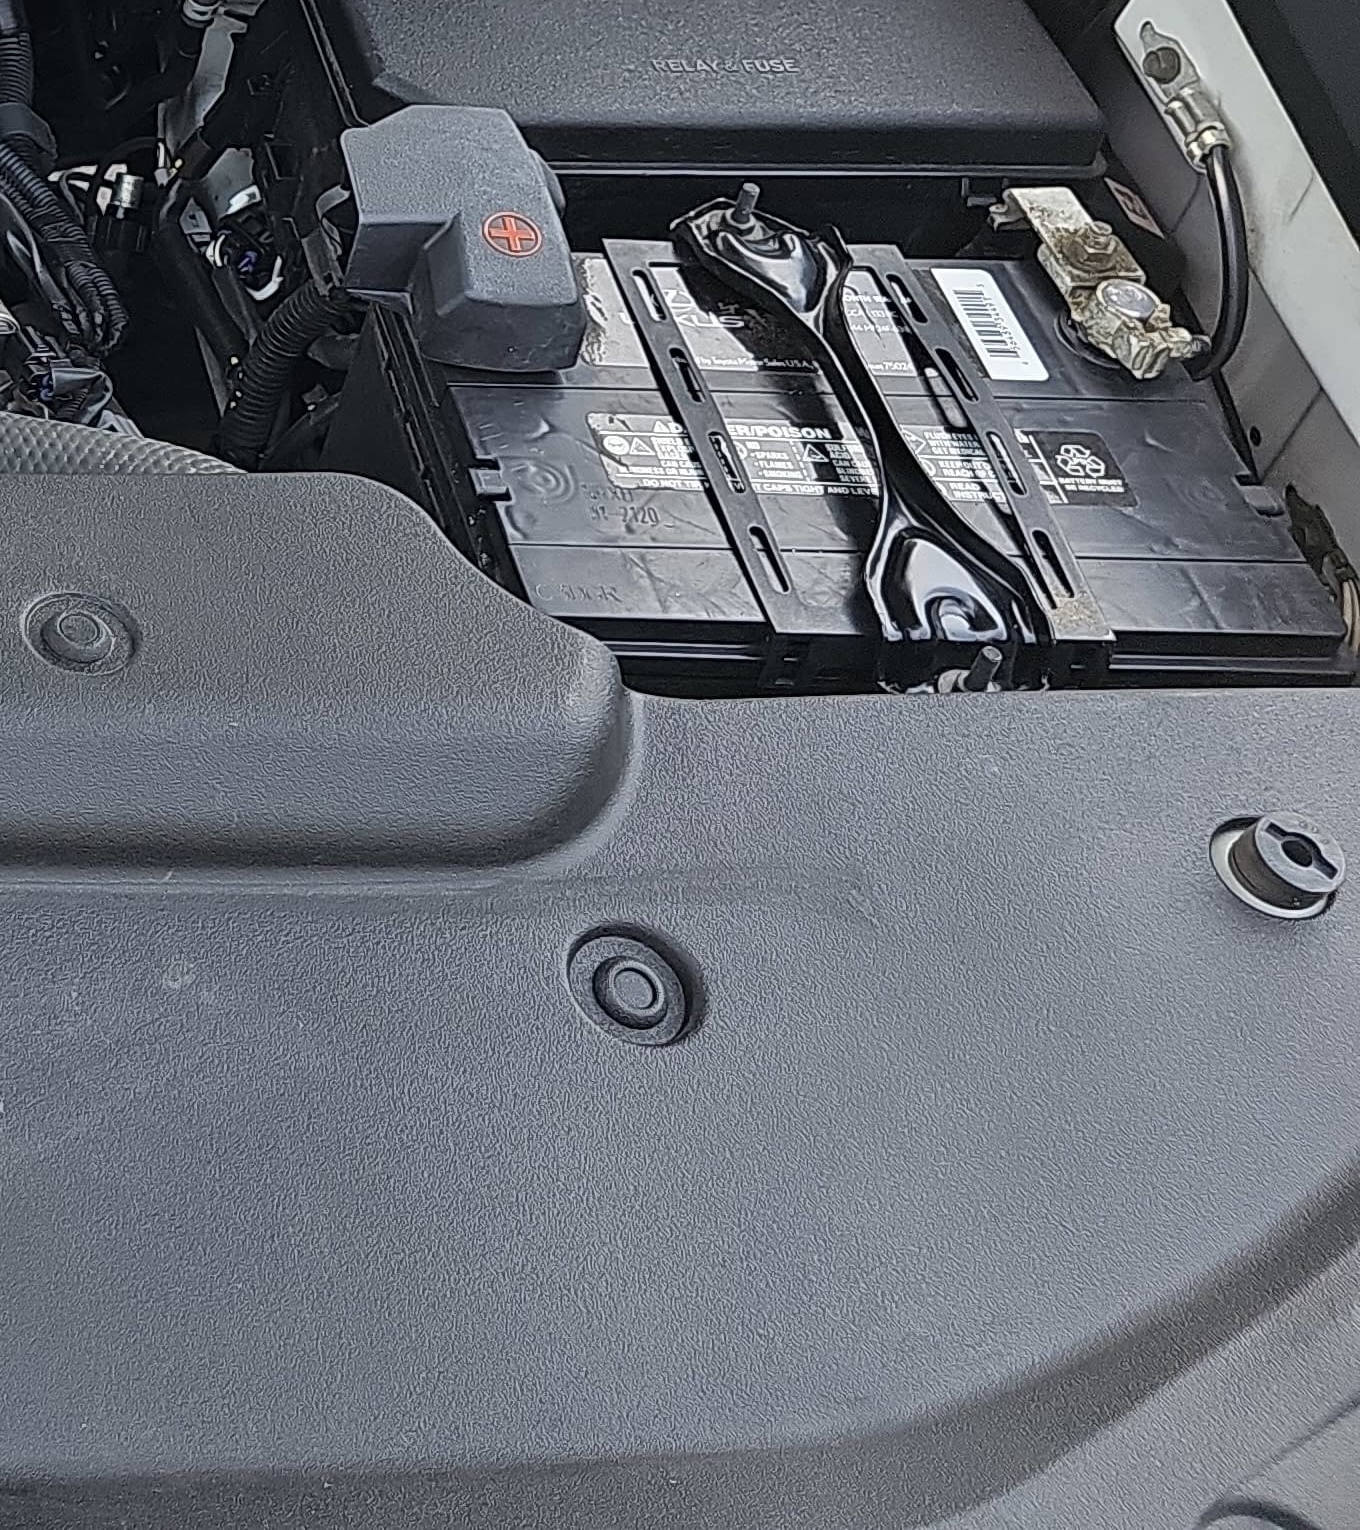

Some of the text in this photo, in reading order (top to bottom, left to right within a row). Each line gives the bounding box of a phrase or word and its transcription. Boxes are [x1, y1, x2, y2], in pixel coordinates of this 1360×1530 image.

[651, 58, 800, 73] RELAY & FUSE
[642, 479, 659, 488] DO
